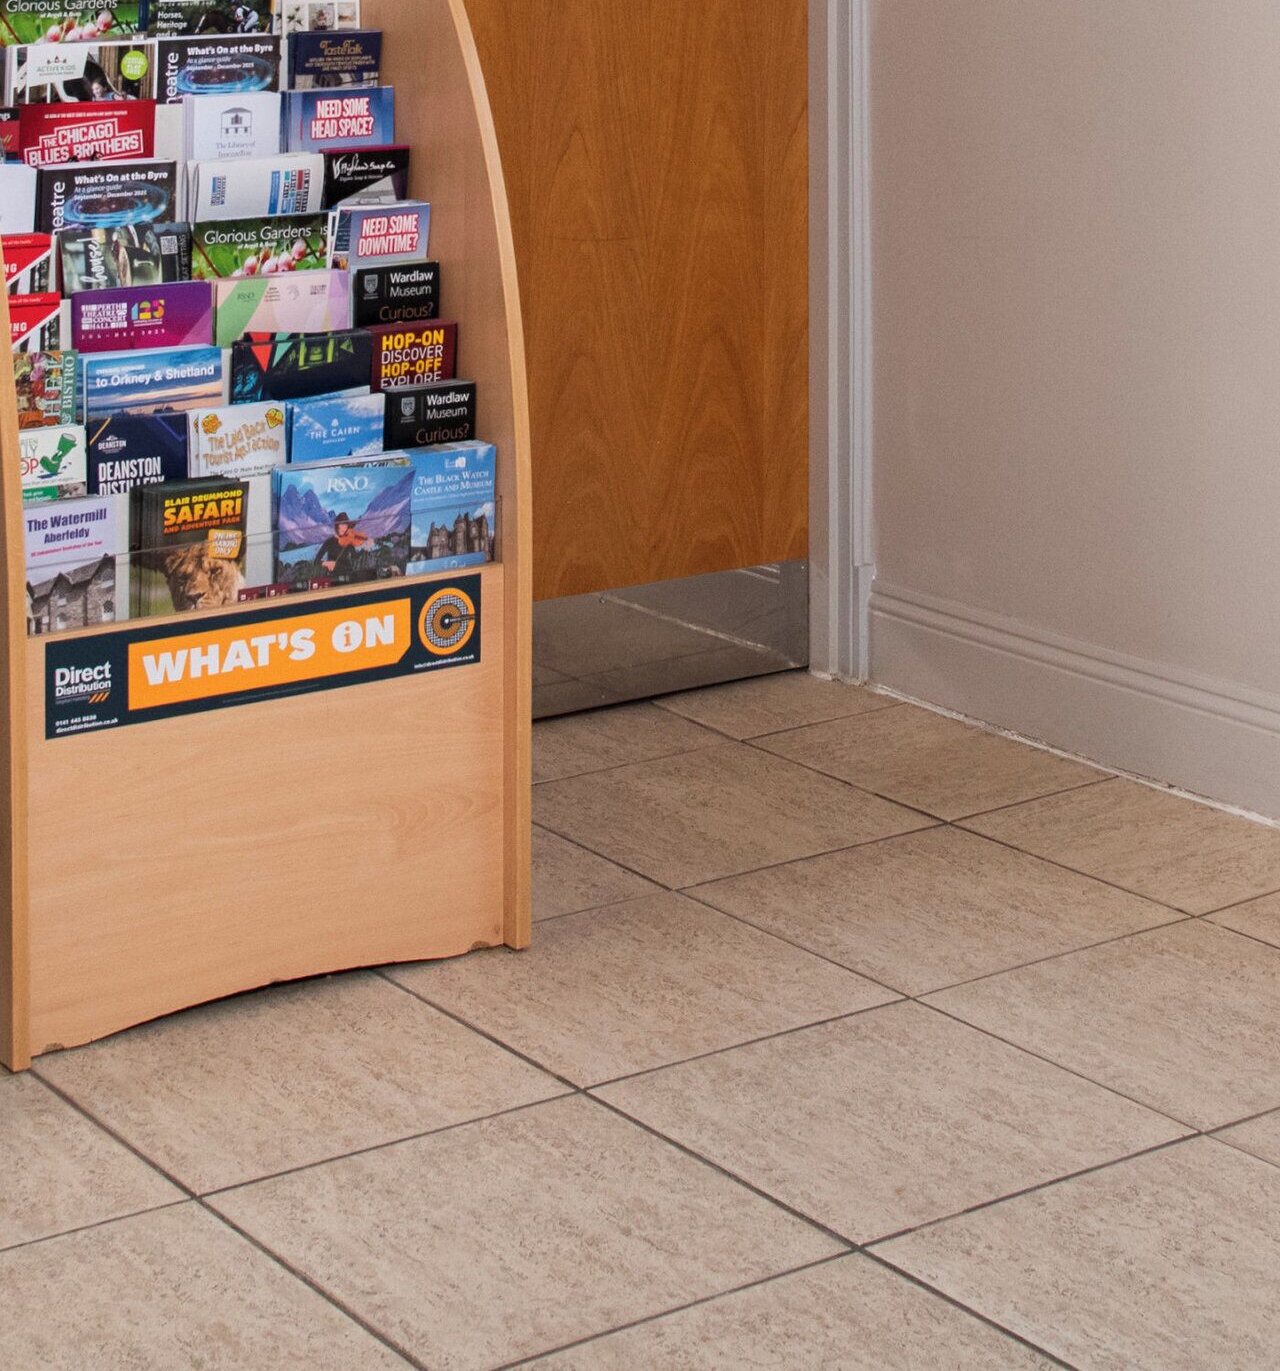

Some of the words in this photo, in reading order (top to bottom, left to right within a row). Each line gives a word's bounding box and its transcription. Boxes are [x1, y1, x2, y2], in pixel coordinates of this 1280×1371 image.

[157, 11, 184, 20] Horses,
[157, 20, 188, 30] Heritage
[187, 46, 215, 56] What's
[216, 45, 228, 55] On
[229, 45, 238, 53] at
[239, 44, 253, 53] the
[254, 44, 274, 54] Byre
[316, 99, 344, 119] NEED
[343, 97, 370, 117] SOME
[43, 137, 57, 148] THE
[58, 123, 114, 147] CHICAGO
[311, 119, 339, 140] HEAD
[338, 116, 375, 137] SPACE?
[28, 146, 70, 167] BLUES
[73, 134, 140, 159] BROTHERS
[227, 141, 251, 151] Library
[74, 174, 105, 185] What's
[106, 173, 119, 182] On
[130, 172, 146, 180] the
[147, 171, 169, 181] Byre
[362, 216, 389, 237] NEED
[389, 214, 419, 235] SOME
[204, 228, 257, 245] Glorious
[260, 226, 312, 240] Gardens
[358, 235, 419, 257] DOWNTIME?
[390, 271, 434, 283] Wardlaw
[390, 284, 432, 298] Museum
[83, 310, 118, 318] THEATRE
[97, 302, 122, 311] PERTH
[131, 299, 165, 321] 125
[379, 302, 434, 321] Curious?
[93, 316, 127, 324] CONCERT
[382, 329, 445, 349] HOP-ON
[381, 345, 443, 364] DISCOVER
[96, 377, 109, 388] to
[110, 372, 151, 387] Orkney
[154, 371, 163, 380] &
[165, 364, 215, 380] Shetland
[381, 358, 442, 377] HOP-OFF
[62, 356, 75, 408] BISTRO
[381, 372, 442, 388] EXPLORE
[426, 392, 470, 406] Wardlaw
[426, 406, 468, 420] Museum
[310, 431, 329, 440] THE
[331, 426, 360, 437] CAIRN
[416, 423, 470, 444] Curious?
[98, 456, 162, 483] DEANSTON
[326, 476, 369, 494] RSNO
[164, 497, 190, 507] BLAIR
[192, 490, 243, 502] DRUMMOND
[27, 519, 49, 532] The
[50, 508, 107, 529] Watermill
[163, 498, 242, 527] SAFARI
[181, 519, 220, 531] ADVENTURE
[44, 526, 90, 544] Aberfeldy
[142, 628, 317, 686] WHAT'S
[331, 614, 395, 654] ON
[55, 660, 112, 687] Direct
[55, 680, 112, 697] Distribution
